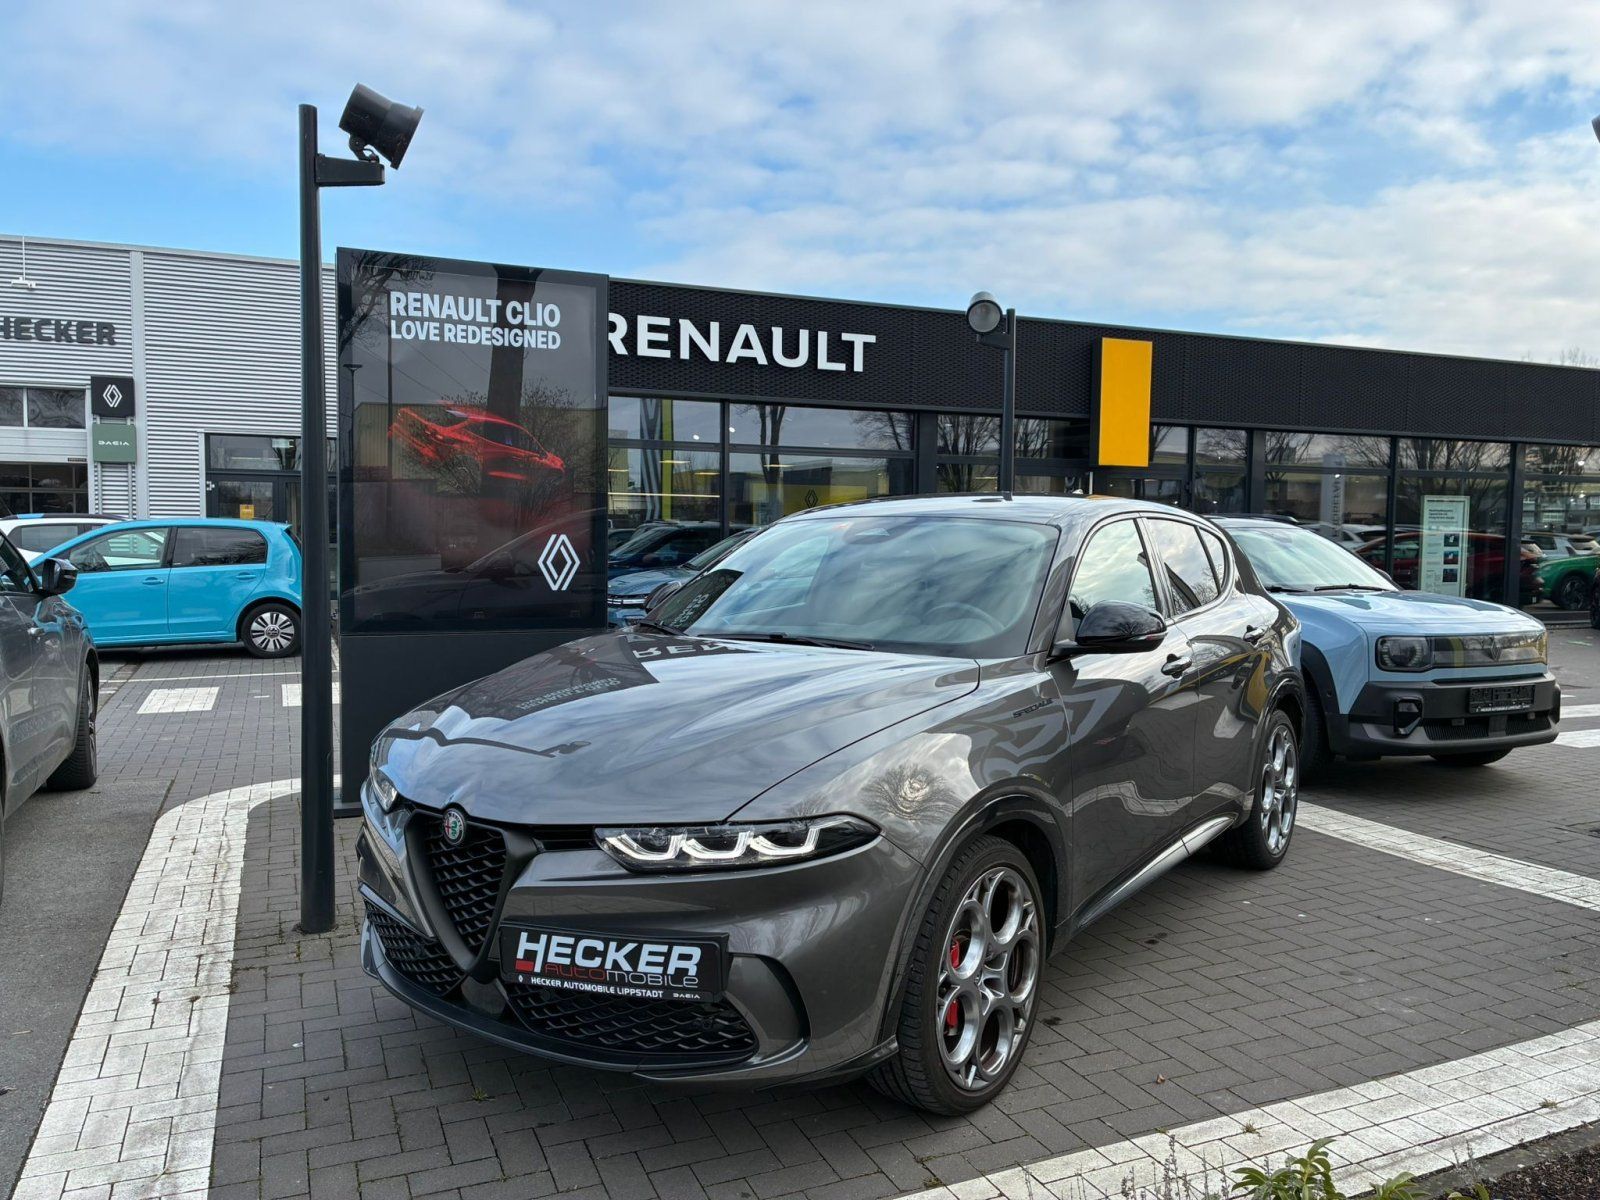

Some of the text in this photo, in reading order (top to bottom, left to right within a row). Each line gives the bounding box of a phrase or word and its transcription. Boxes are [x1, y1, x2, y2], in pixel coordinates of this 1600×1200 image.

[390, 291, 561, 327] RENAULT CLIO
[390, 320, 561, 350] LOVE REDESIGNED
[608, 312, 877, 372] RENAULT
[516, 931, 702, 976] HECKER
[531, 976, 664, 998] HECKER AUTOMOBILE LIPPSTADT
